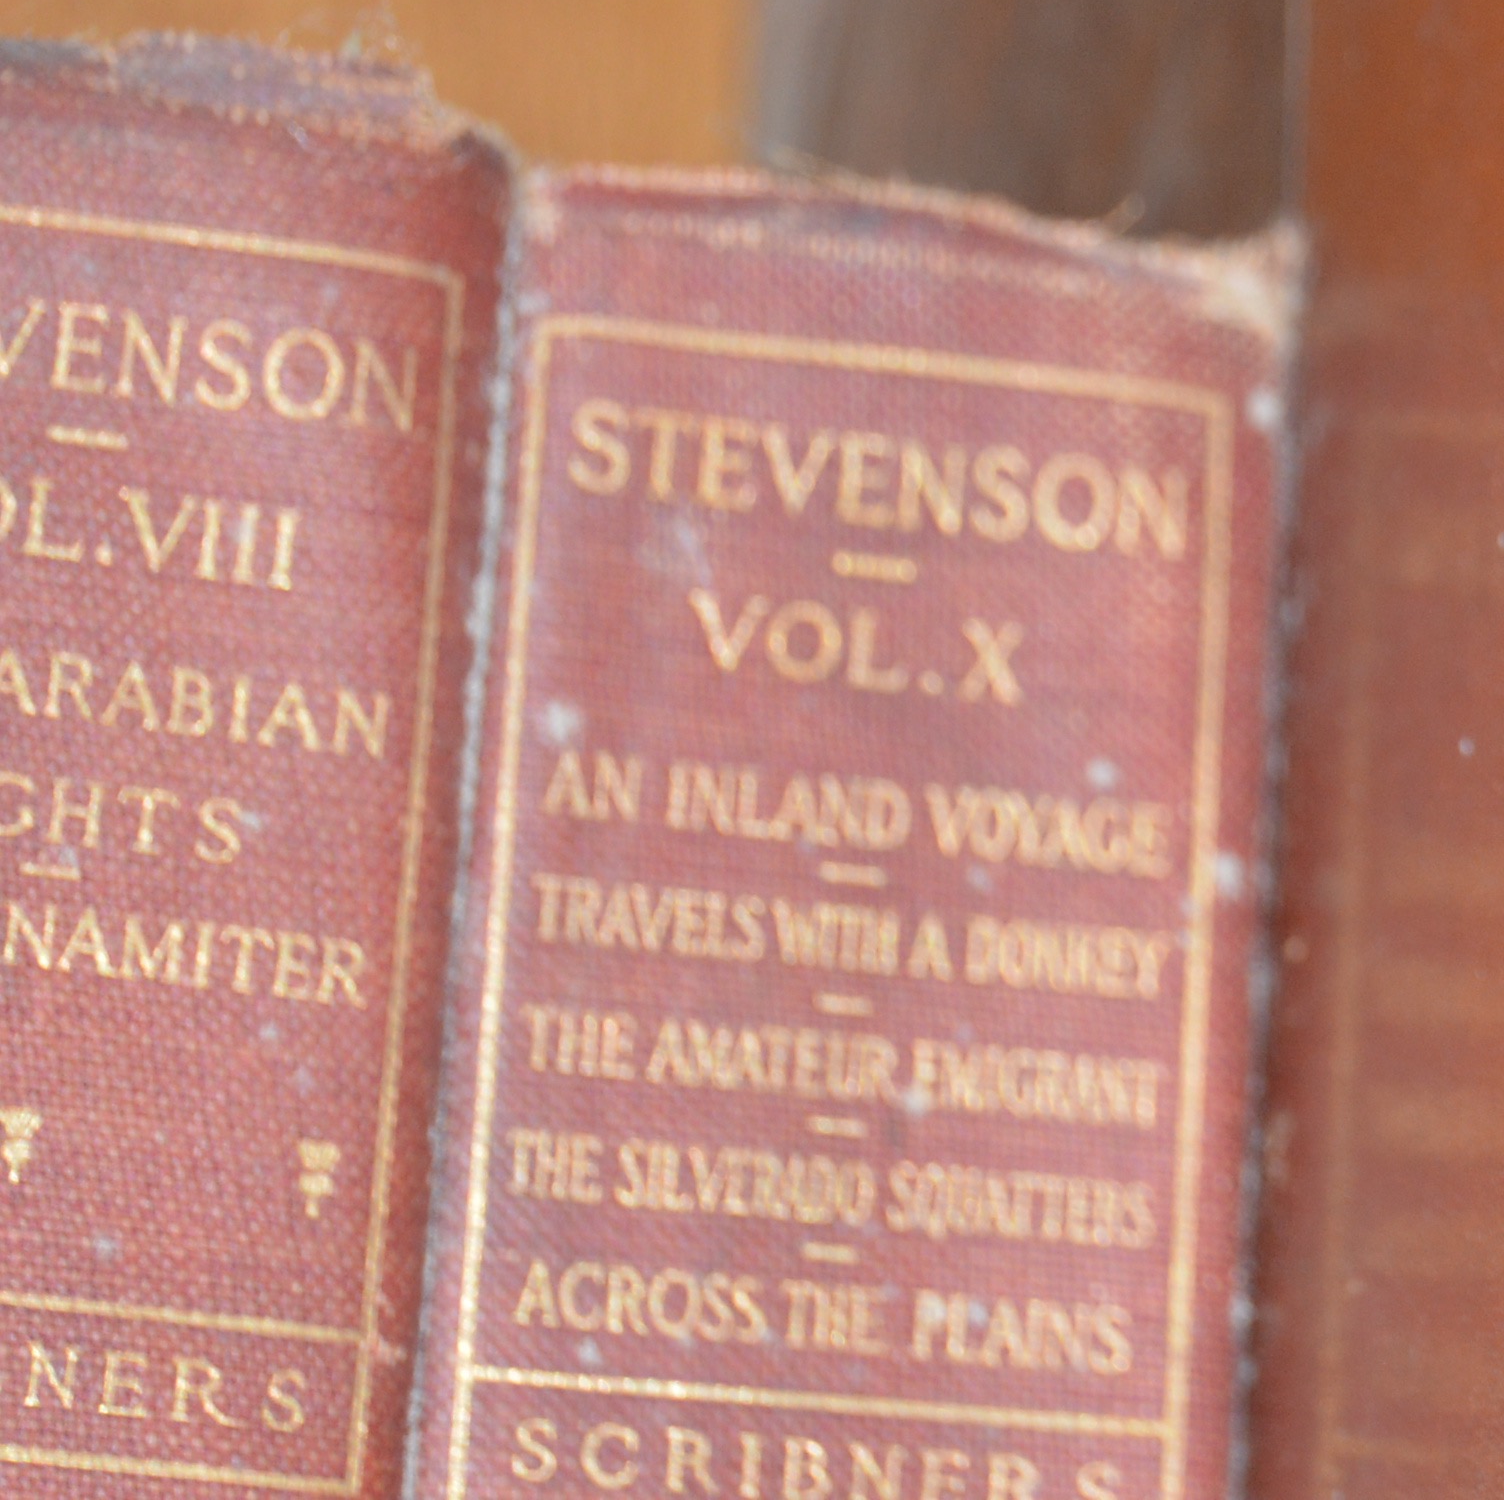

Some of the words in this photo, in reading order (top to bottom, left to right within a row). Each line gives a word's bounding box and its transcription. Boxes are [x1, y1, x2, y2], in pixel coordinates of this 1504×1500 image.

[566, 397, 1190, 562] STEVENSON
[0, 648, 390, 758] ARABIAN
[545, 750, 642, 824] AN
[666, 758, 914, 852] INLAND
[924, 782, 1176, 882] VOYAGE
[0, 904, 367, 1010] NAMITER
[530, 870, 768, 964] TRAVELS
[772, 894, 900, 978] WITH
[908, 914, 952, 984] A
[964, 914, 1170, 1000] DONKEY
[522, 1002, 637, 1082] THE
[644, 1016, 902, 1104] AMATEUR
[908, 1036, 1168, 1130] EMIGRANT
[505, 1126, 604, 1204] THE
[614, 1136, 876, 1226] SILVERADO
[886, 1160, 1156, 1250] SQUATTERS
[514, 1258, 768, 1346] ACROSS
[778, 1278, 888, 1358] THE
[910, 1288, 1134, 1376] PLAINS
